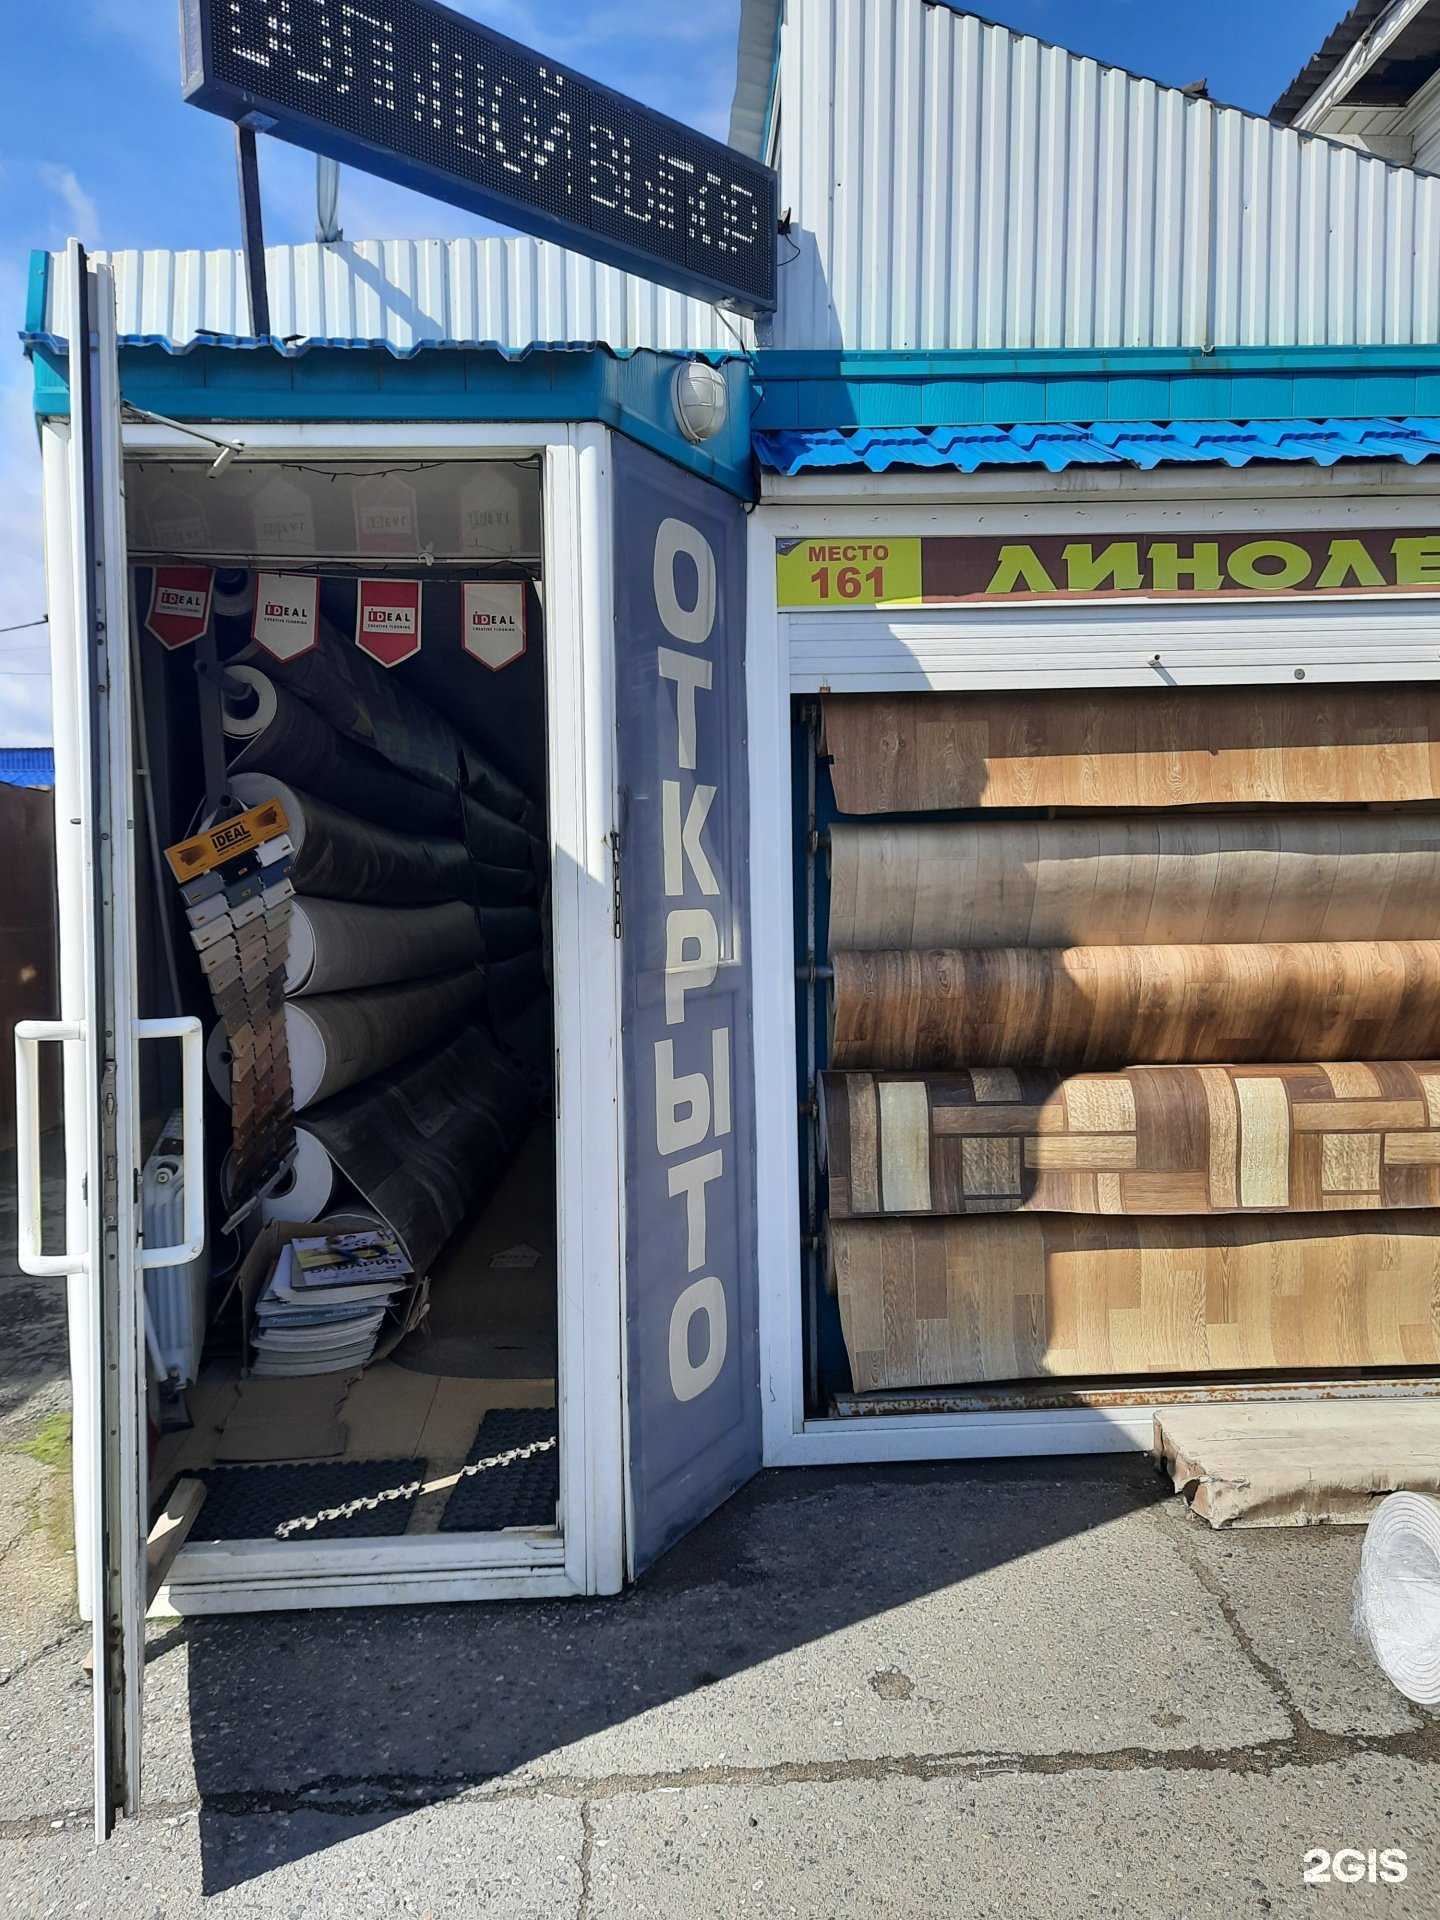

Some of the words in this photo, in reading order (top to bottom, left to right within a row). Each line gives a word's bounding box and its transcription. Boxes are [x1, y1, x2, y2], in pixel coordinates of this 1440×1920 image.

[808, 544, 889, 562] МЕСТО
[811, 566, 885, 599] 161
[212, 824, 249, 846] IDEAL
[653, 517, 731, 1402] ОТКРЫТО
